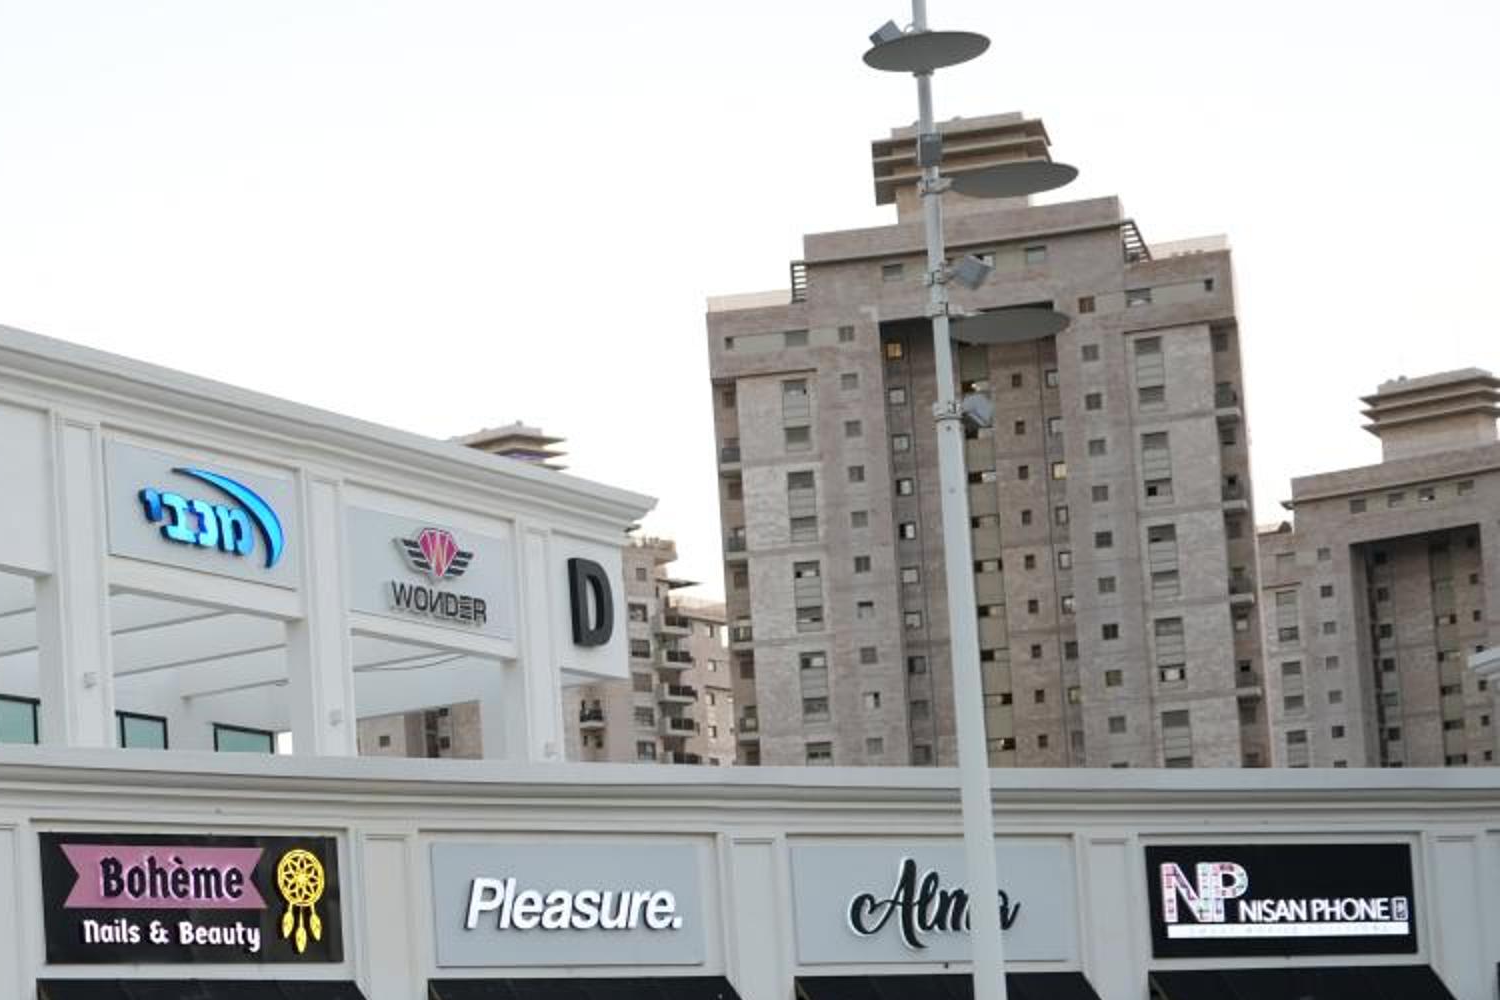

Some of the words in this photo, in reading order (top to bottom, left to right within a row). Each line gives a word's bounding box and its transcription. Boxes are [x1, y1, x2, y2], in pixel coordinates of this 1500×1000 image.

[138, 487, 255, 556] מכבי
[567, 557, 615, 648] D
[100, 856, 245, 900] Bohème
[464, 877, 684, 931] Pleasure.
[1239, 898, 1307, 922] NISAN
[1311, 897, 1390, 922] PHONE
[82, 919, 141, 944] Nails
[148, 920, 170, 944] &
[178, 921, 261, 952] Beauty
